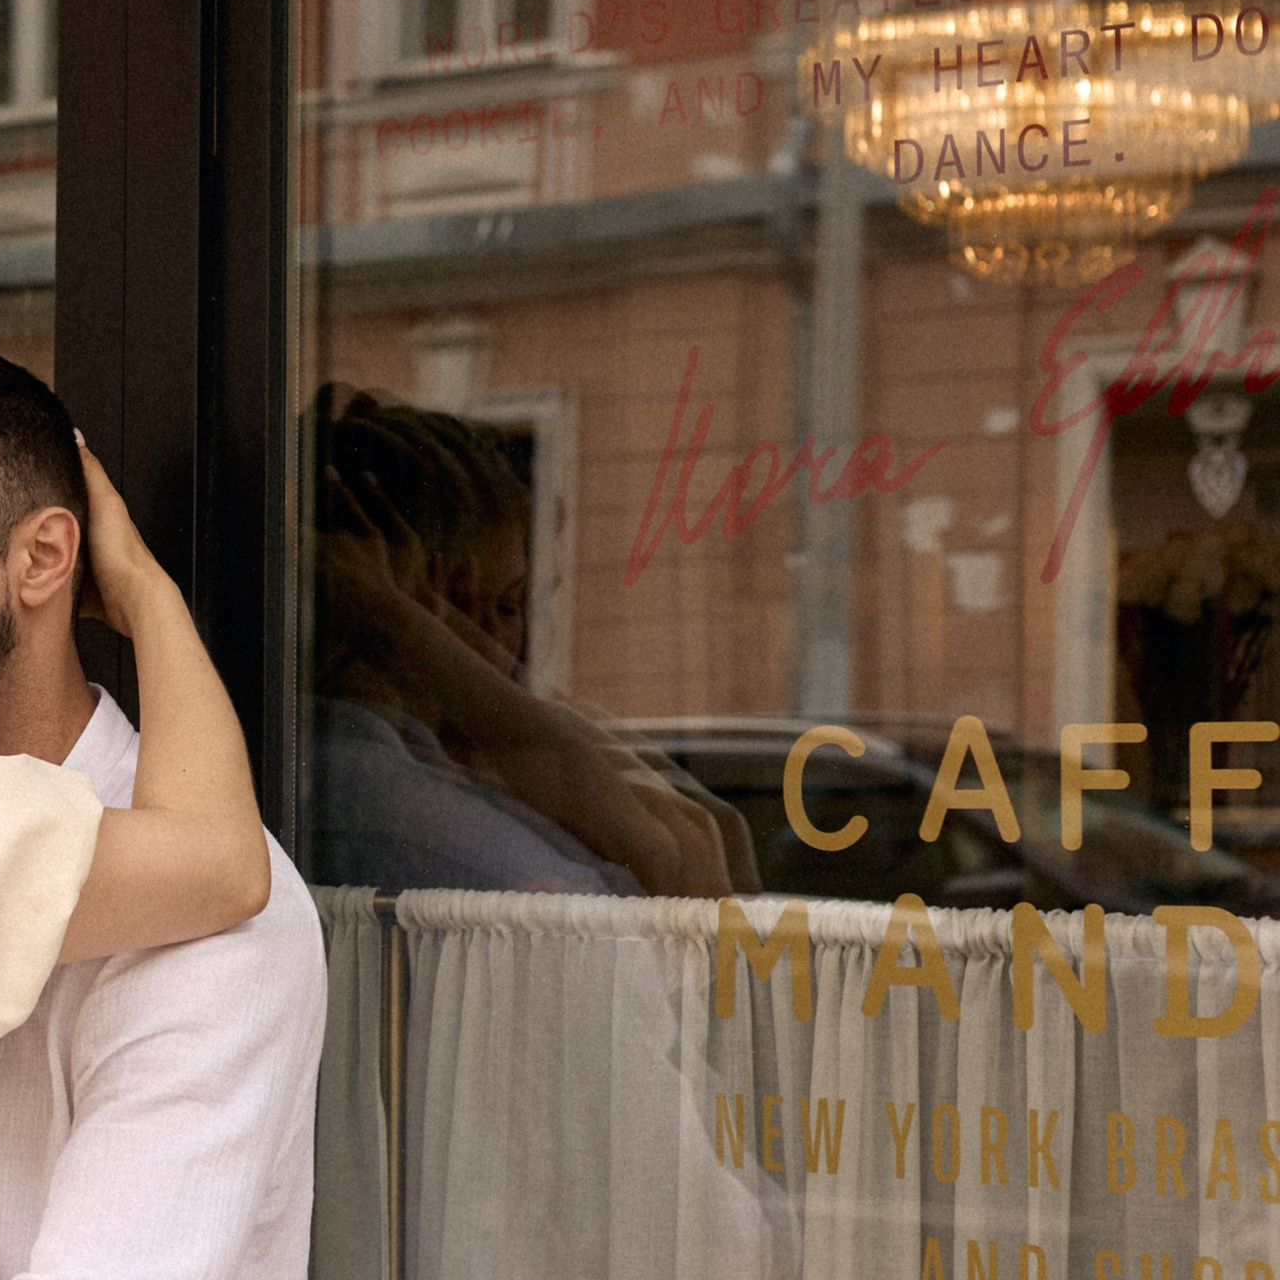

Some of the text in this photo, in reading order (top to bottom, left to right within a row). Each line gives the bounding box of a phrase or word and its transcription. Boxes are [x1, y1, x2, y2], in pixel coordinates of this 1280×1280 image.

[658, 70, 765, 125] AND
[811, 54, 882, 109] MY
[932, 21, 1136, 94] HEART
[1190, 5, 1270, 63] DO
[892, 117, 1126, 186] DANCE.
[782, 714, 1280, 853] CAFF
[715, 892, 1262, 1039] MAND
[714, 1092, 846, 1176] NEW
[885, 1100, 1061, 1189] YORK
